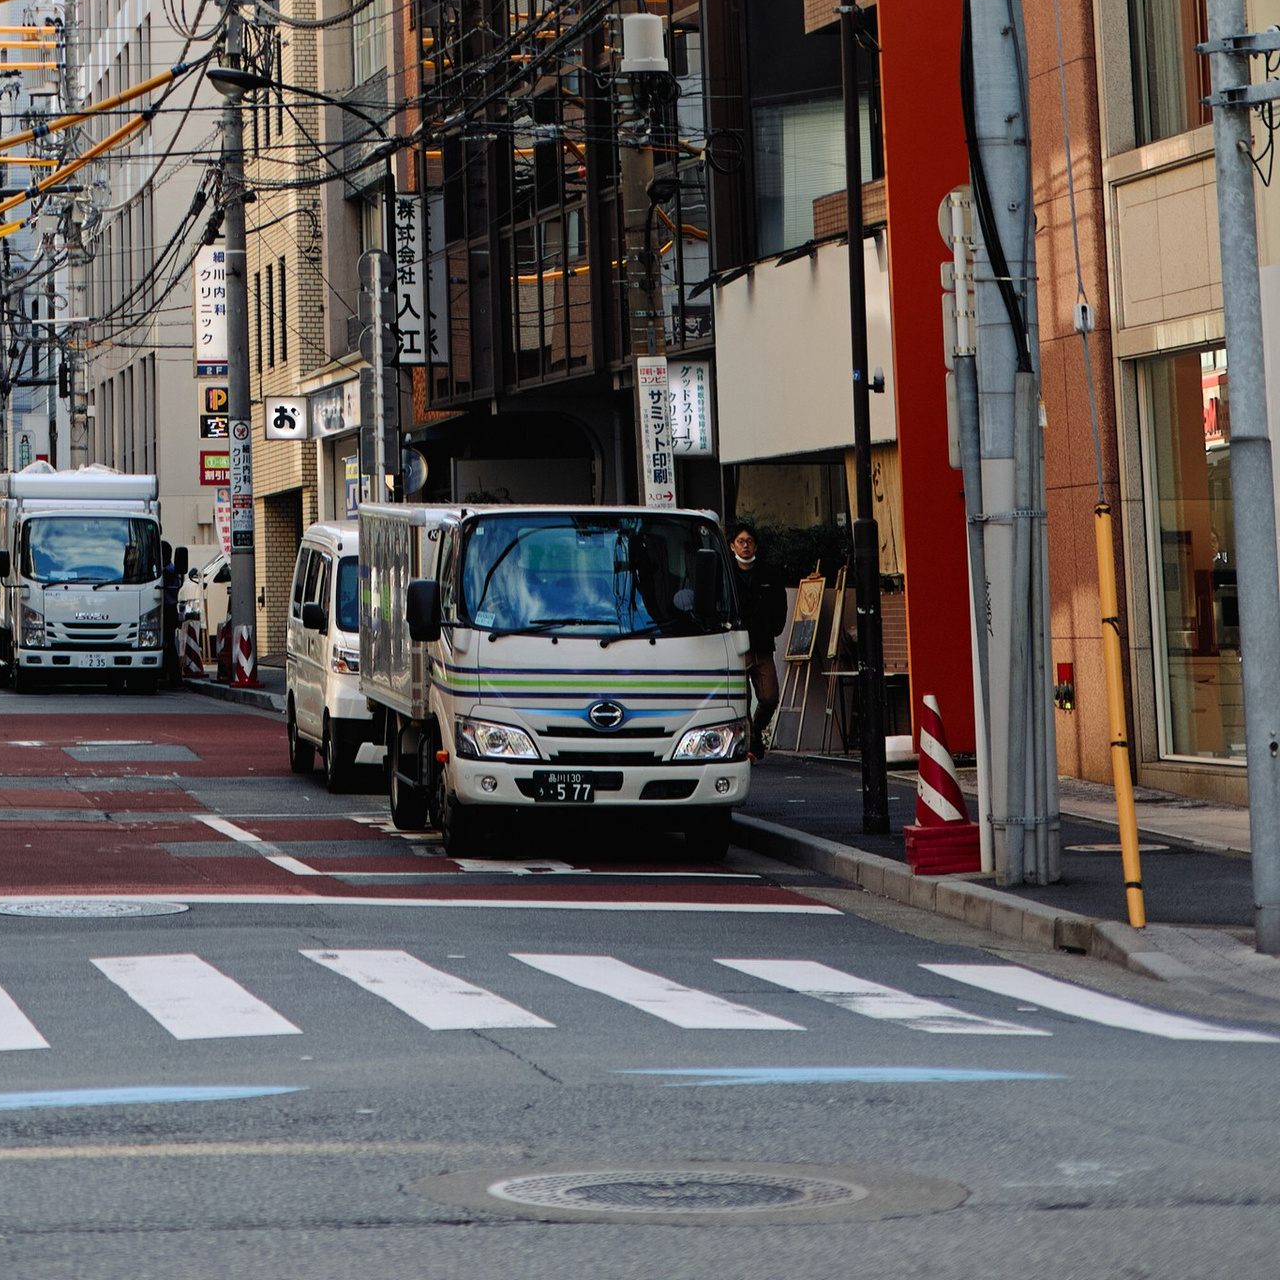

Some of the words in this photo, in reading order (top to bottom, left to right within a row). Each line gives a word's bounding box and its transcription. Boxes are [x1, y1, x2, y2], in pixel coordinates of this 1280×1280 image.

[200, 269, 213, 345] クリニック
[213, 251, 226, 316] 細川内科
[207, 416, 229, 438] 空
[273, 405, 300, 431] お
[648, 390, 668, 485] サミット印刷
[680, 365, 694, 451] グッドスリープ
[75, 612, 109, 620] ISUZU
